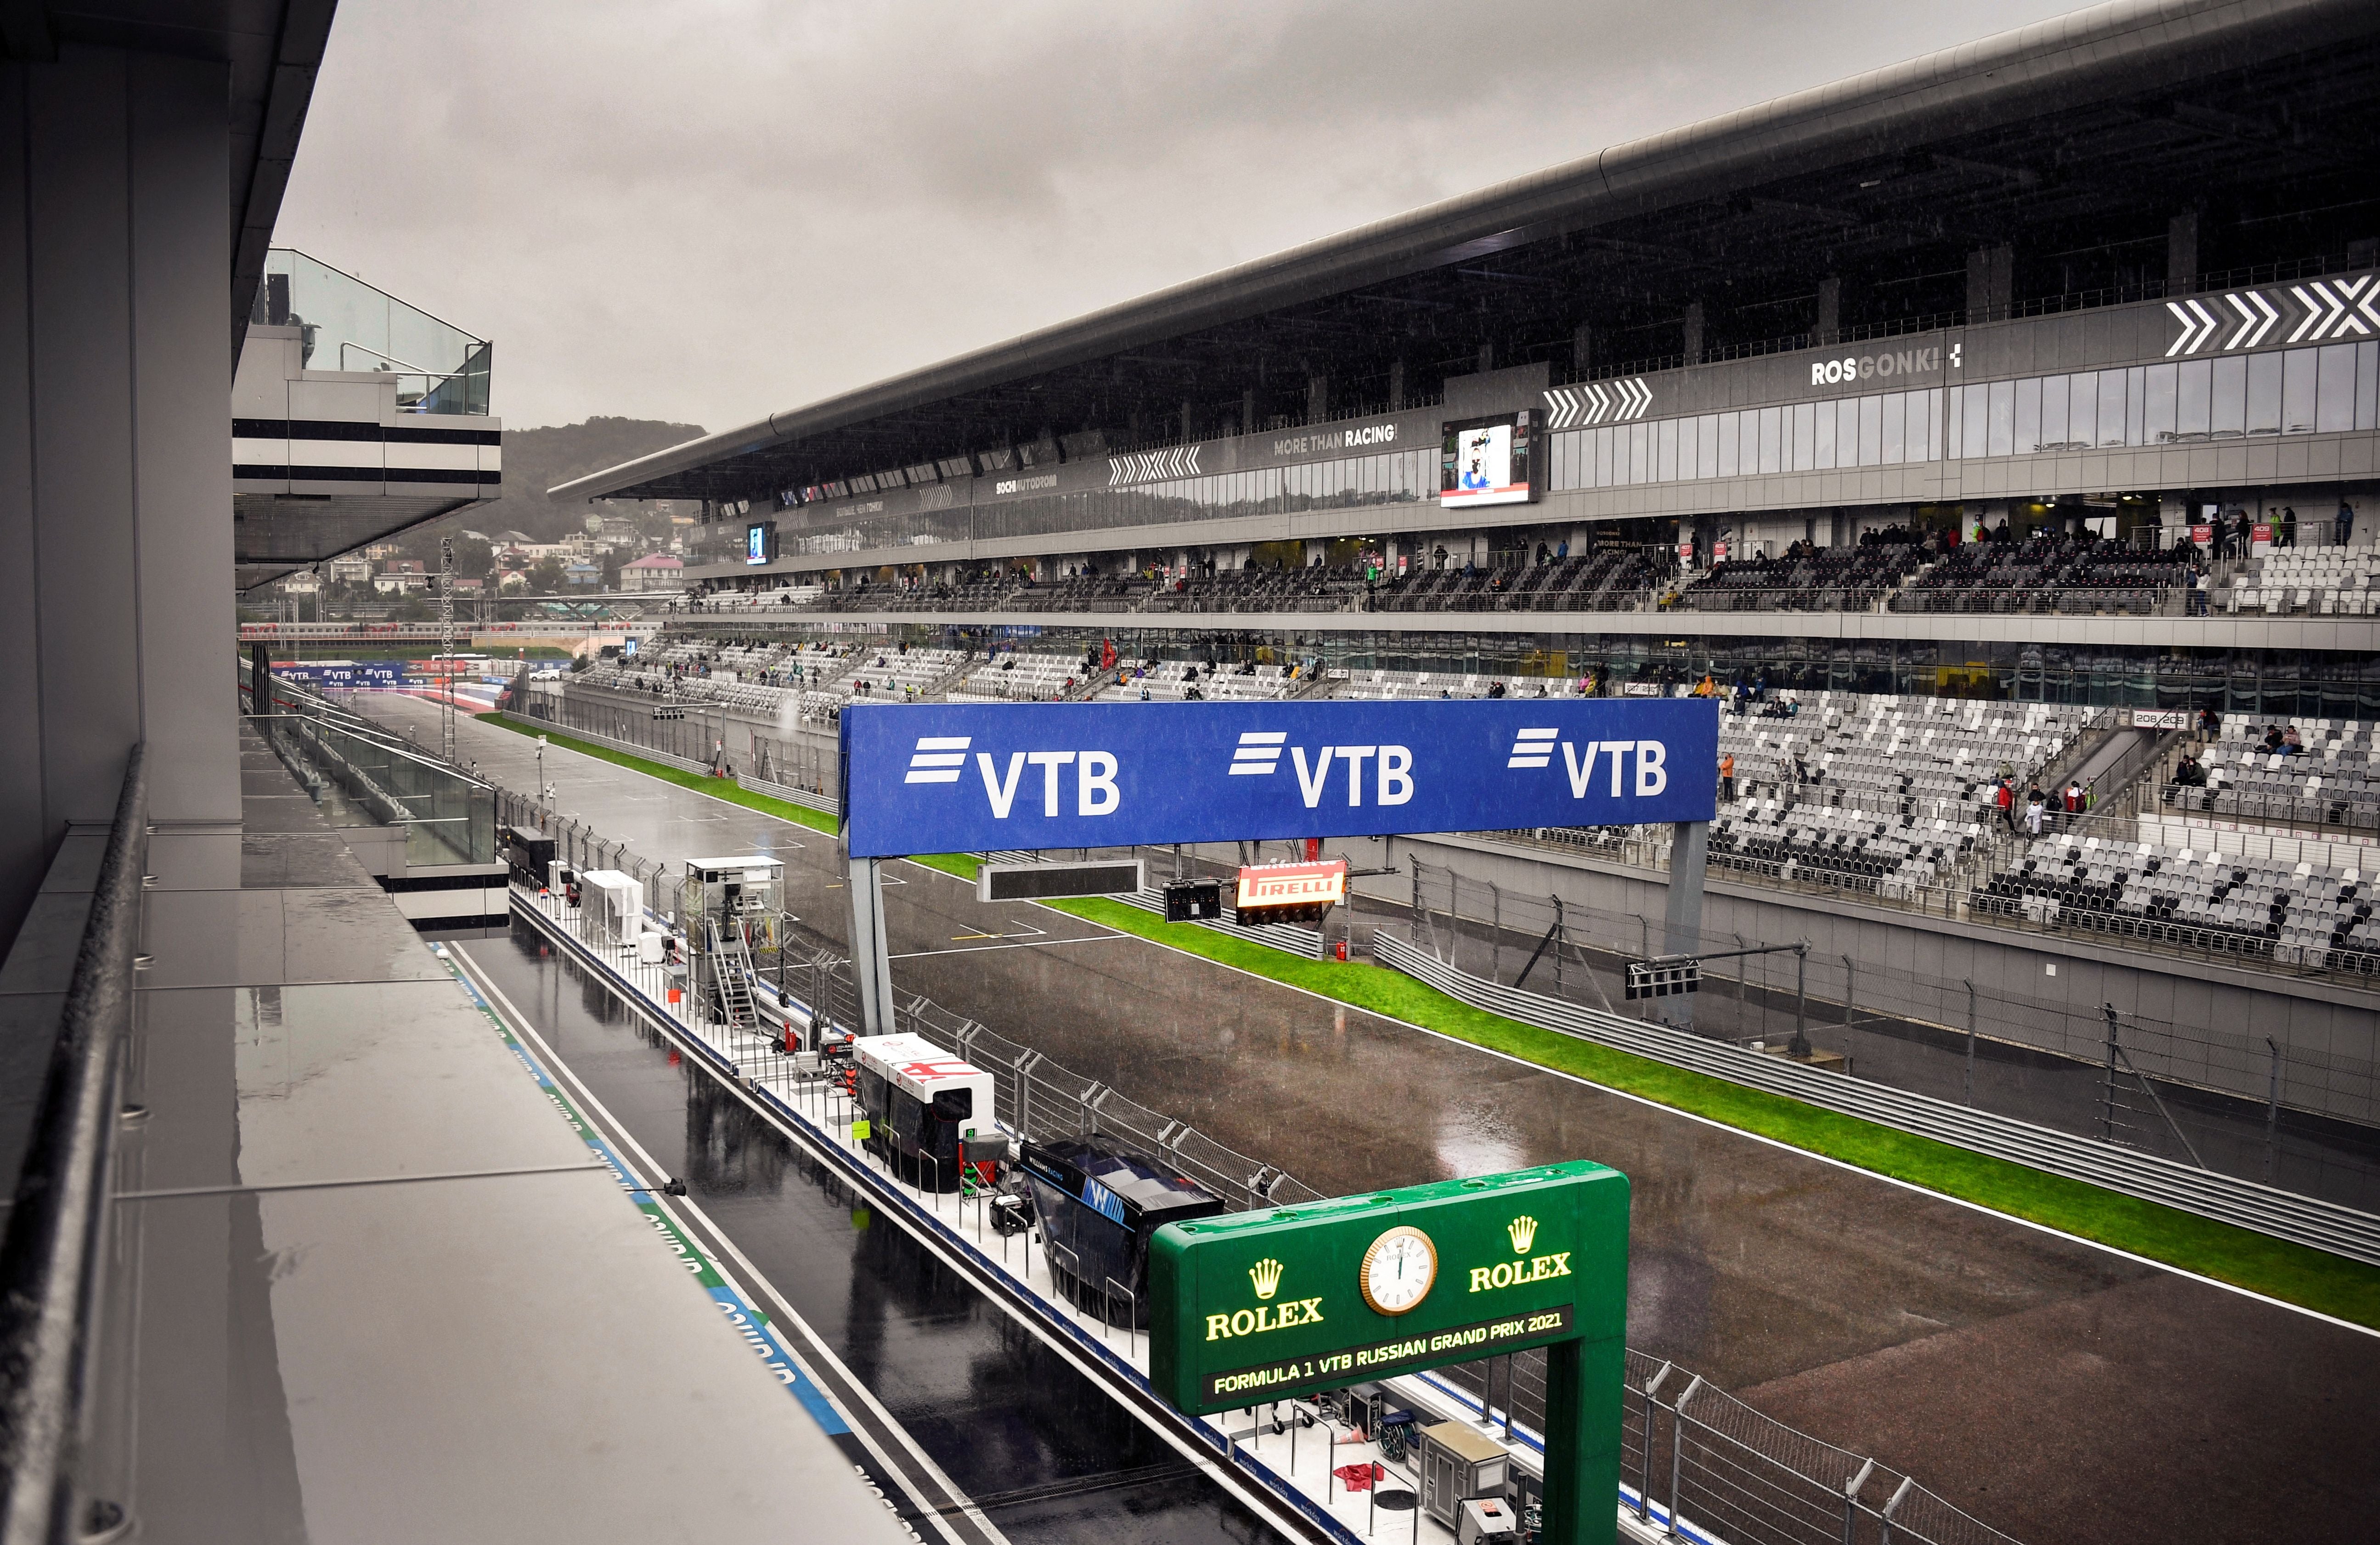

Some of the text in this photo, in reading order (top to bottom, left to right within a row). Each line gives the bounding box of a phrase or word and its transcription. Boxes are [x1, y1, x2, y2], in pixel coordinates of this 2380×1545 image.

[1811, 347, 1939, 386] ROSGONKI
[1274, 423, 1398, 456] MORE THAN RACING!
[332, 671, 351, 680] VTB
[374, 670, 393, 679] VTB
[2163, 716, 2184, 724] 209
[1290, 745, 1414, 808] VTB
[1562, 740, 1667, 799] VTB
[976, 750, 1120, 819] VTB
[1248, 873, 1335, 897] PIRELLI
[1029, 1156, 1063, 1181] WILLIAMS RACING
[1469, 1252, 1572, 1293] ROLEX
[1206, 1297, 1324, 1341] ROLEX
[1105, 1355, 1119, 1370] workday
[1214, 1313, 1562, 1394] FORMULA 1 VTB RUSSIAN GRAND PRIX 2021
[1128, 1373, 1143, 1388] workday
[1203, 1431, 1221, 1448] workday
[1239, 1457, 1258, 1475] workday
[1269, 1479, 1289, 1498] workday
[1300, 1503, 1320, 1523] workday
